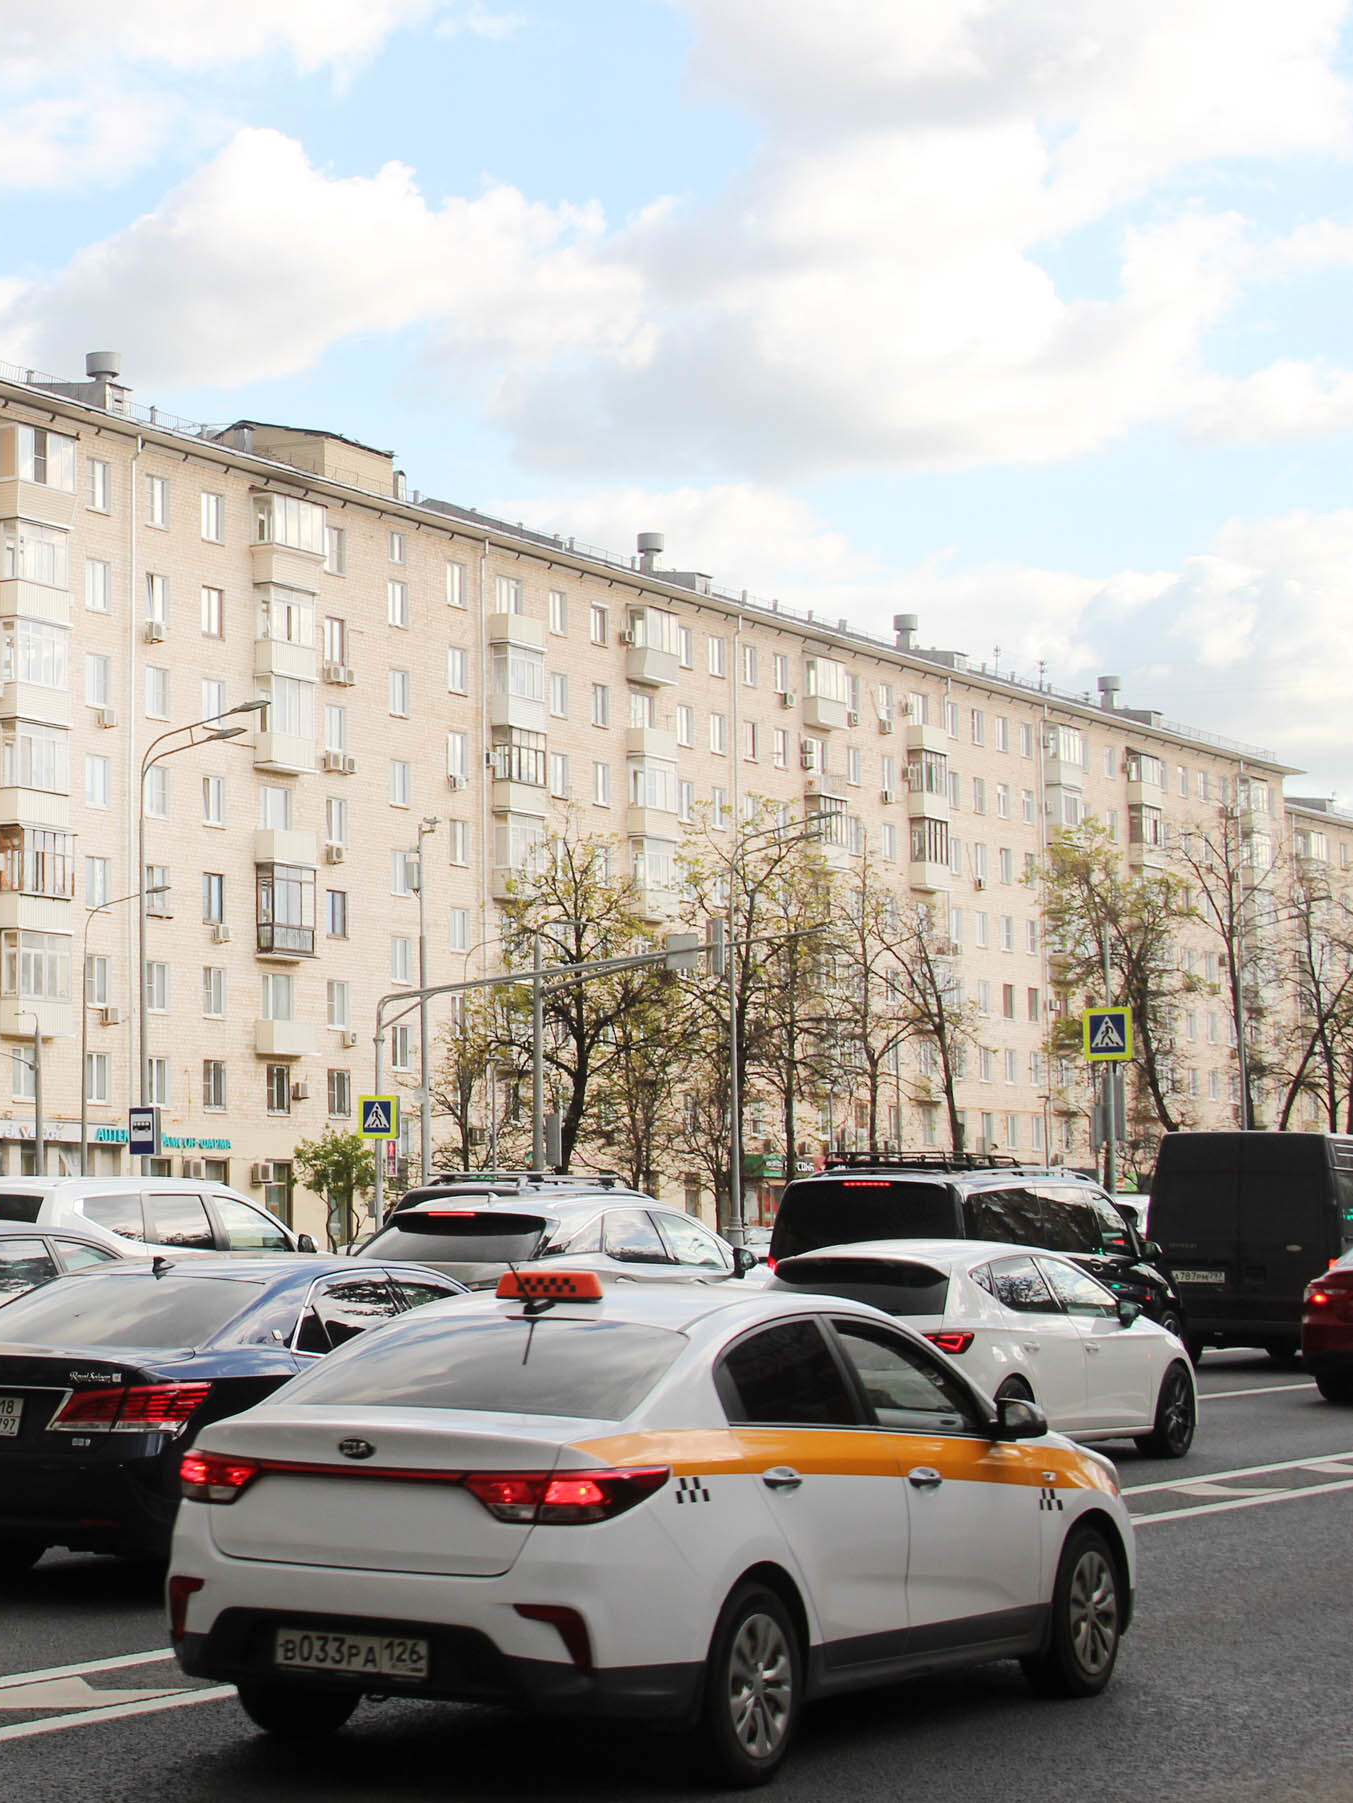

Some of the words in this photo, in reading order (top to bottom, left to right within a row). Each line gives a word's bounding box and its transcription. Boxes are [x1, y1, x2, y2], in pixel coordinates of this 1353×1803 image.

[96, 1127, 130, 1142] АПТЕК
[283, 1634, 377, 1667] В033РА
[383, 1640, 421, 1663] 126
